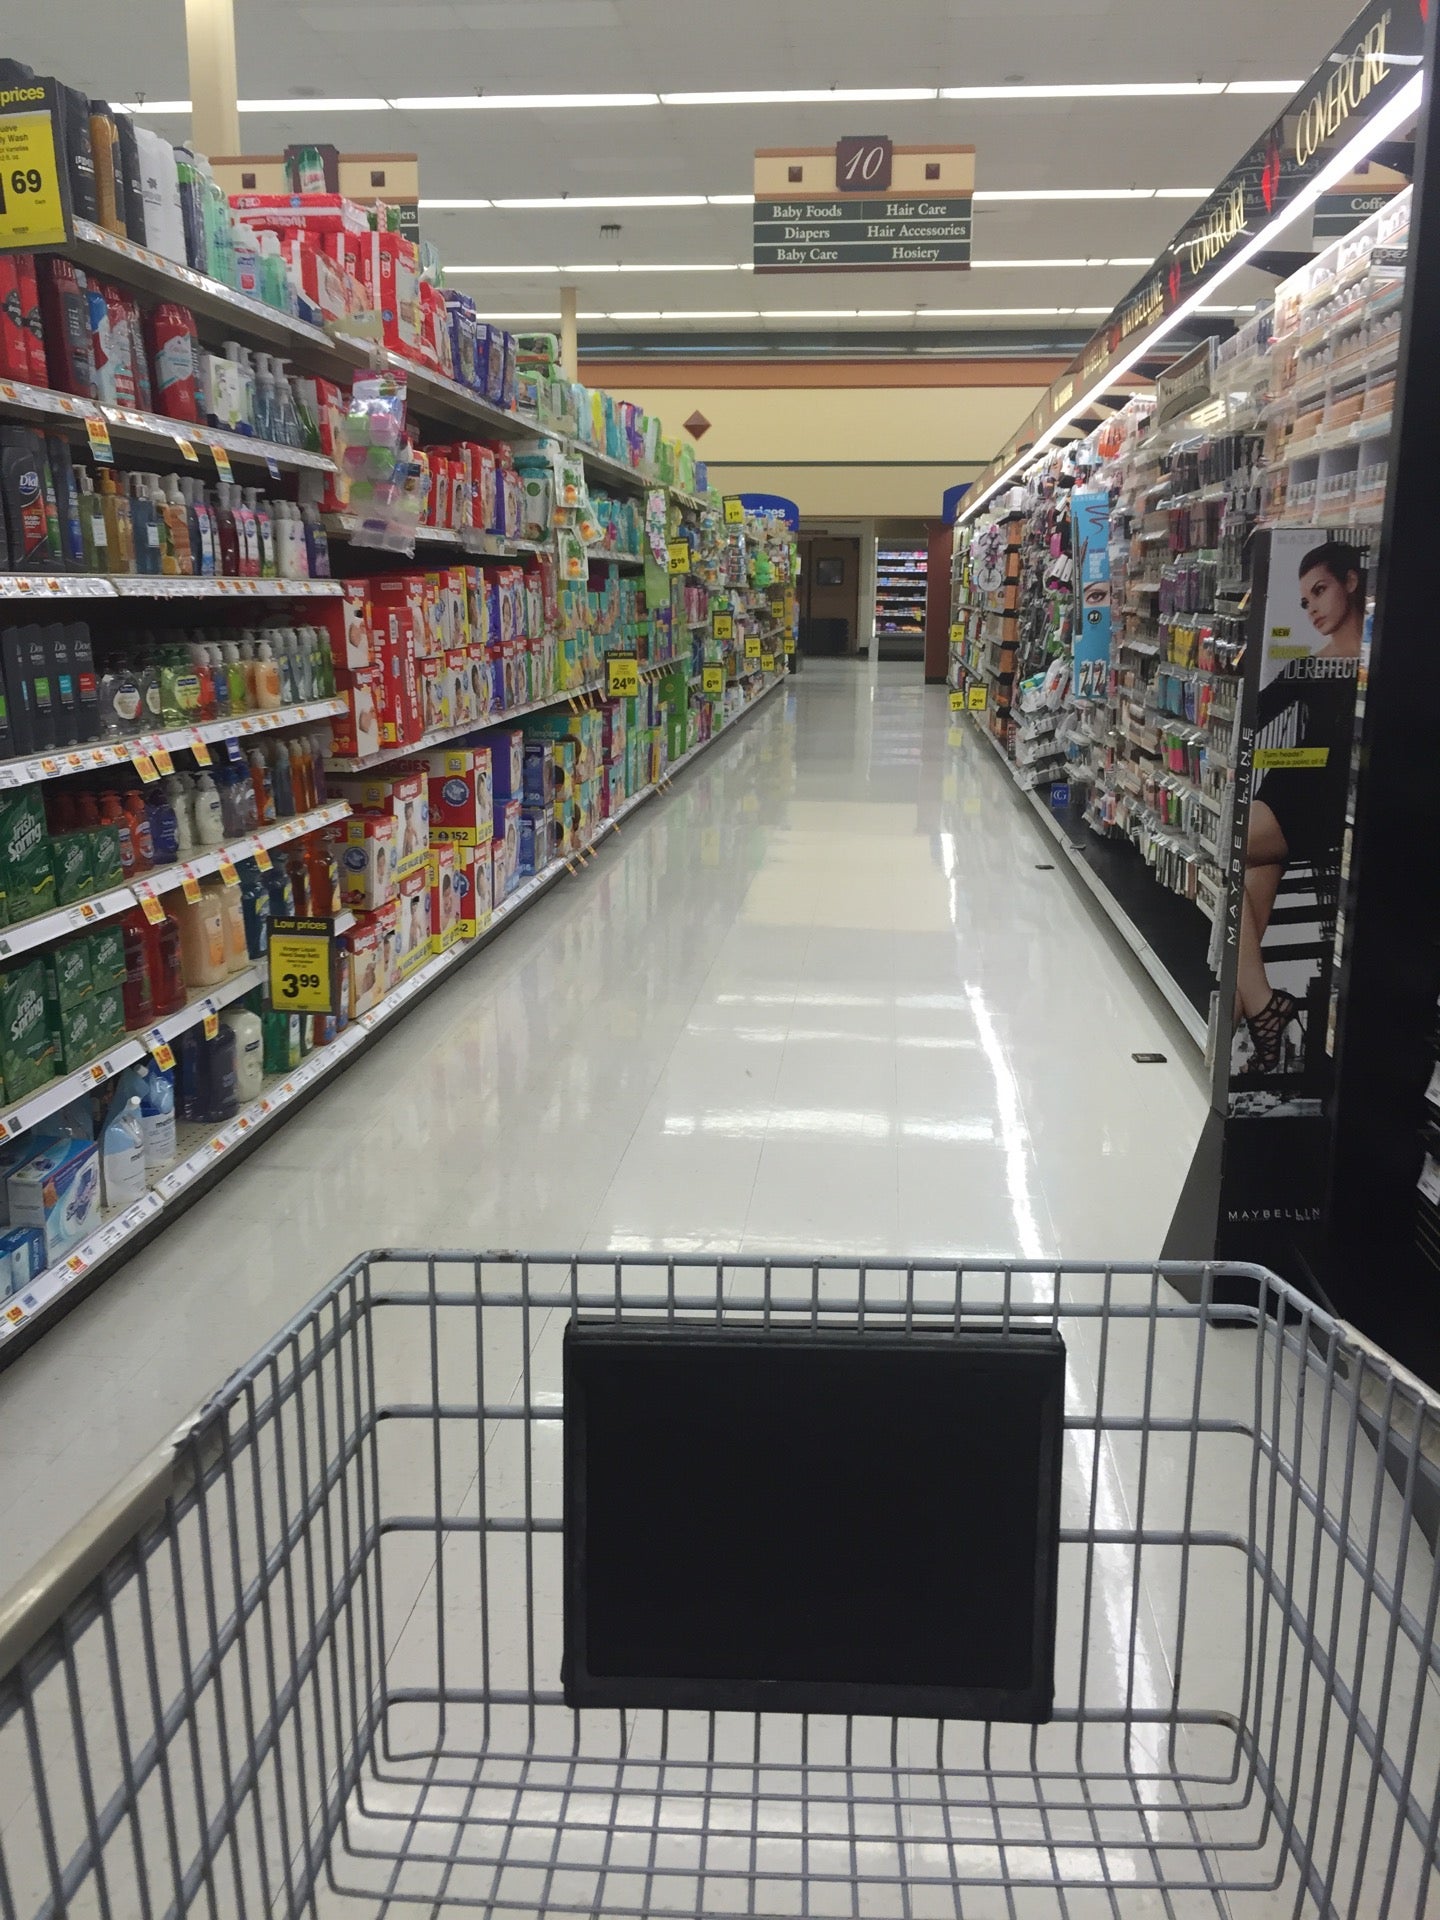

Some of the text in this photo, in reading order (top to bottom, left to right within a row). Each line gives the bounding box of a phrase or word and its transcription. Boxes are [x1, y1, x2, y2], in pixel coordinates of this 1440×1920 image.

[1296, 13, 1390, 166] COVERGIRL
[845, 146, 884, 180] 10
[886, 203, 947, 216] Hair Care
[1351, 197, 1387, 210] Coffe
[772, 204, 842, 220] Baby Foods
[784, 227, 830, 242] Diapers
[867, 223, 966, 238] Hair Accessories
[1190, 180, 1247, 274] COVERGIRL
[777, 247, 838, 263] Baby Care
[892, 247, 939, 261] Hosiery
[20, 474, 38, 487] Dial
[406, 630, 418, 720] HUGGIES
[13, 812, 35, 840] Irish
[8, 823, 42, 863] Spring
[452, 831, 469, 841] 152
[1227, 726, 1251, 946] MAYBELLINE
[274, 920, 327, 932] Low prices
[18, 990, 36, 1016] Irish
[11, 996, 44, 1042] Spring
